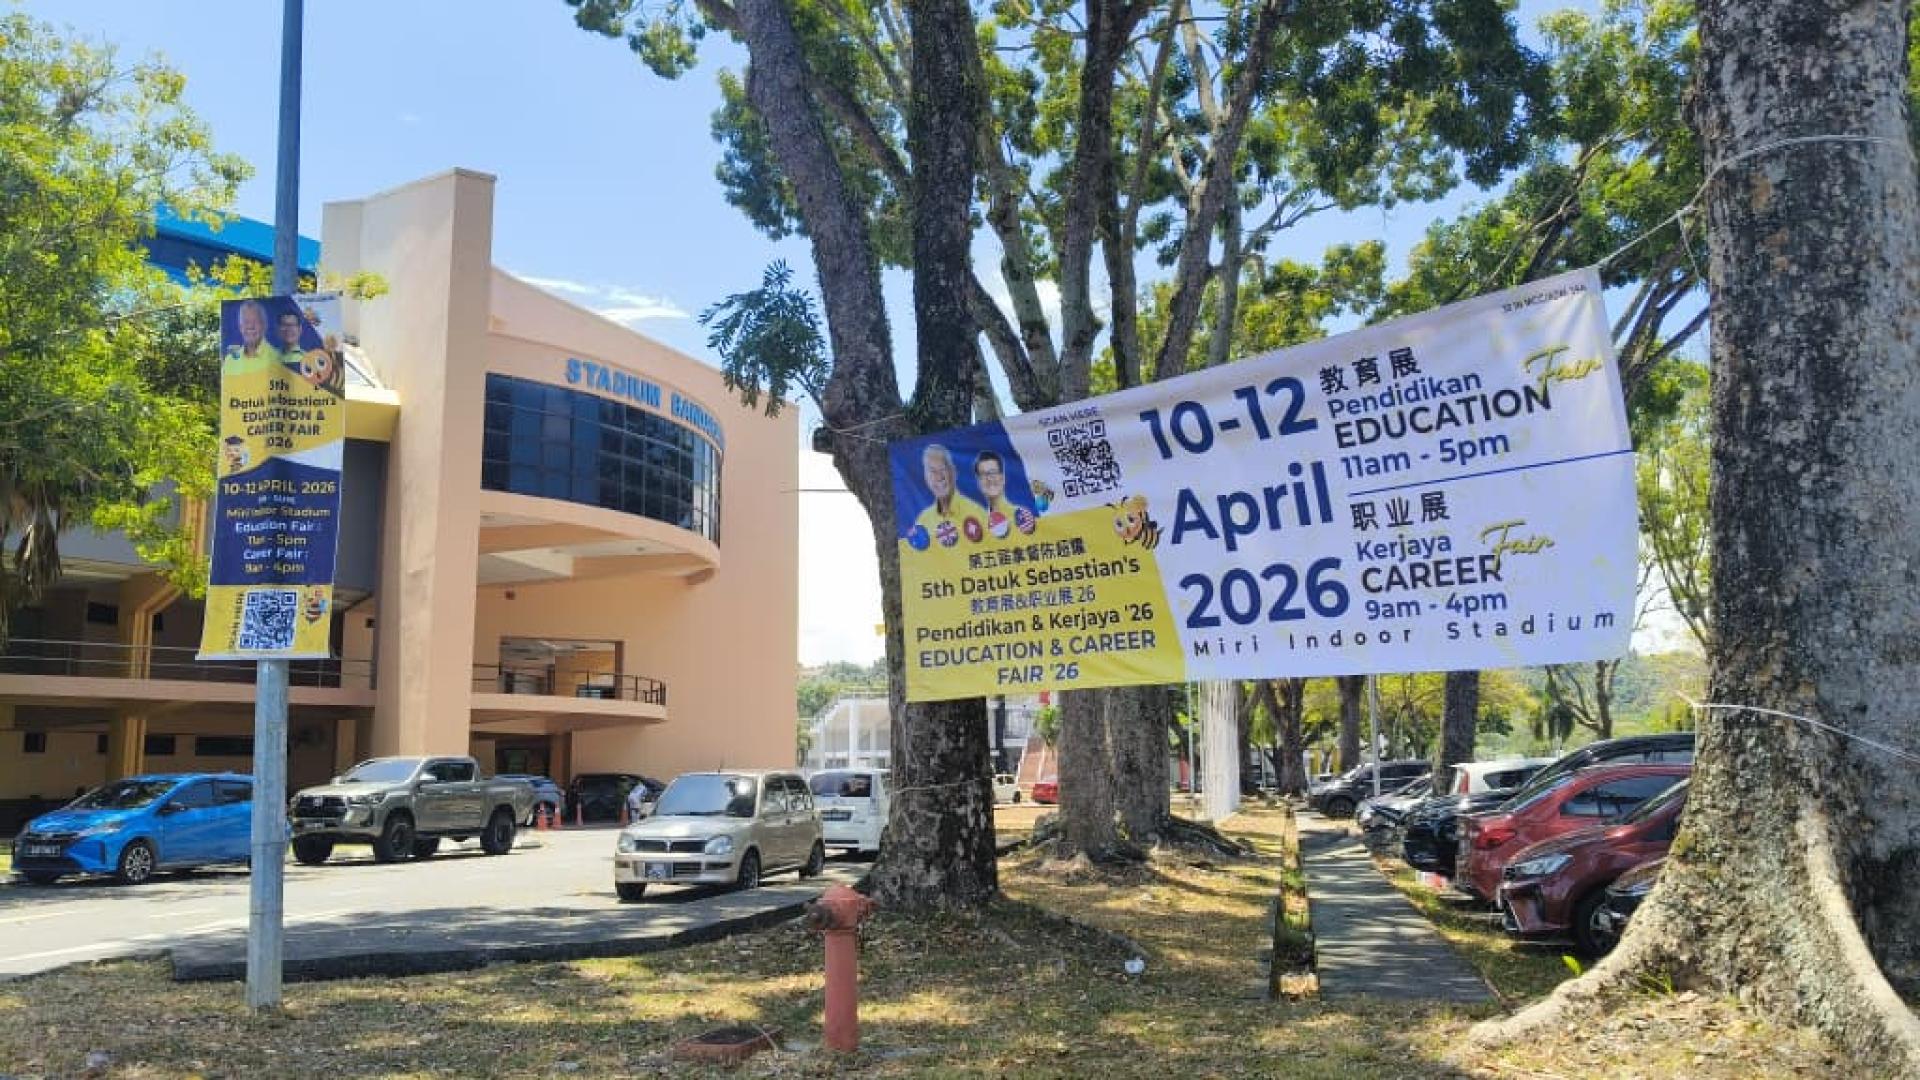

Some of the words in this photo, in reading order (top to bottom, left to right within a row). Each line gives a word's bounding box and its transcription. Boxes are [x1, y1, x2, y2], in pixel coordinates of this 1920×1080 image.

[566, 357, 662, 409] STADIUM
[1319, 346, 1421, 395] 教育展
[1524, 345, 1603, 394] Fair
[1327, 371, 1482, 419] Pendidikan
[1334, 385, 1551, 449] EDUCATION
[290, 423, 320, 436] FAIR
[1140, 376, 1318, 460] 10-12
[1341, 451, 1410, 480] 11am
[1439, 432, 1510, 465] 5pm
[301, 481, 336, 495] 2026
[1171, 461, 1334, 551] April
[1350, 490, 1449, 531] 职业展
[276, 533, 307, 547] 5pm
[1356, 534, 1451, 563] Kerjaya
[1480, 519, 1556, 573] Fair
[922, 580, 955, 600] 5th
[961, 570, 1021, 595] Datuk
[1026, 556, 1141, 586] Sebastian's
[1179, 556, 1350, 628] 2026
[1361, 554, 1503, 593] CAREER
[916, 618, 1026, 643] Pendidikan
[1032, 615, 1043, 631] &
[1050, 609, 1120, 632] Kerjaya
[1125, 603, 1154, 622] '26
[1365, 599, 1421, 620] 9am
[1445, 592, 1507, 618] 4pm
[920, 639, 1043, 668] EDUCATION
[1051, 638, 1063, 656] &
[1069, 630, 1156, 655] CAREER
[1194, 635, 1260, 657] Miri
[1289, 628, 1410, 650] Indoor
[1446, 610, 1615, 640] Stadium
[998, 664, 1043, 685] FAIR
[1050, 662, 1079, 681] '26
